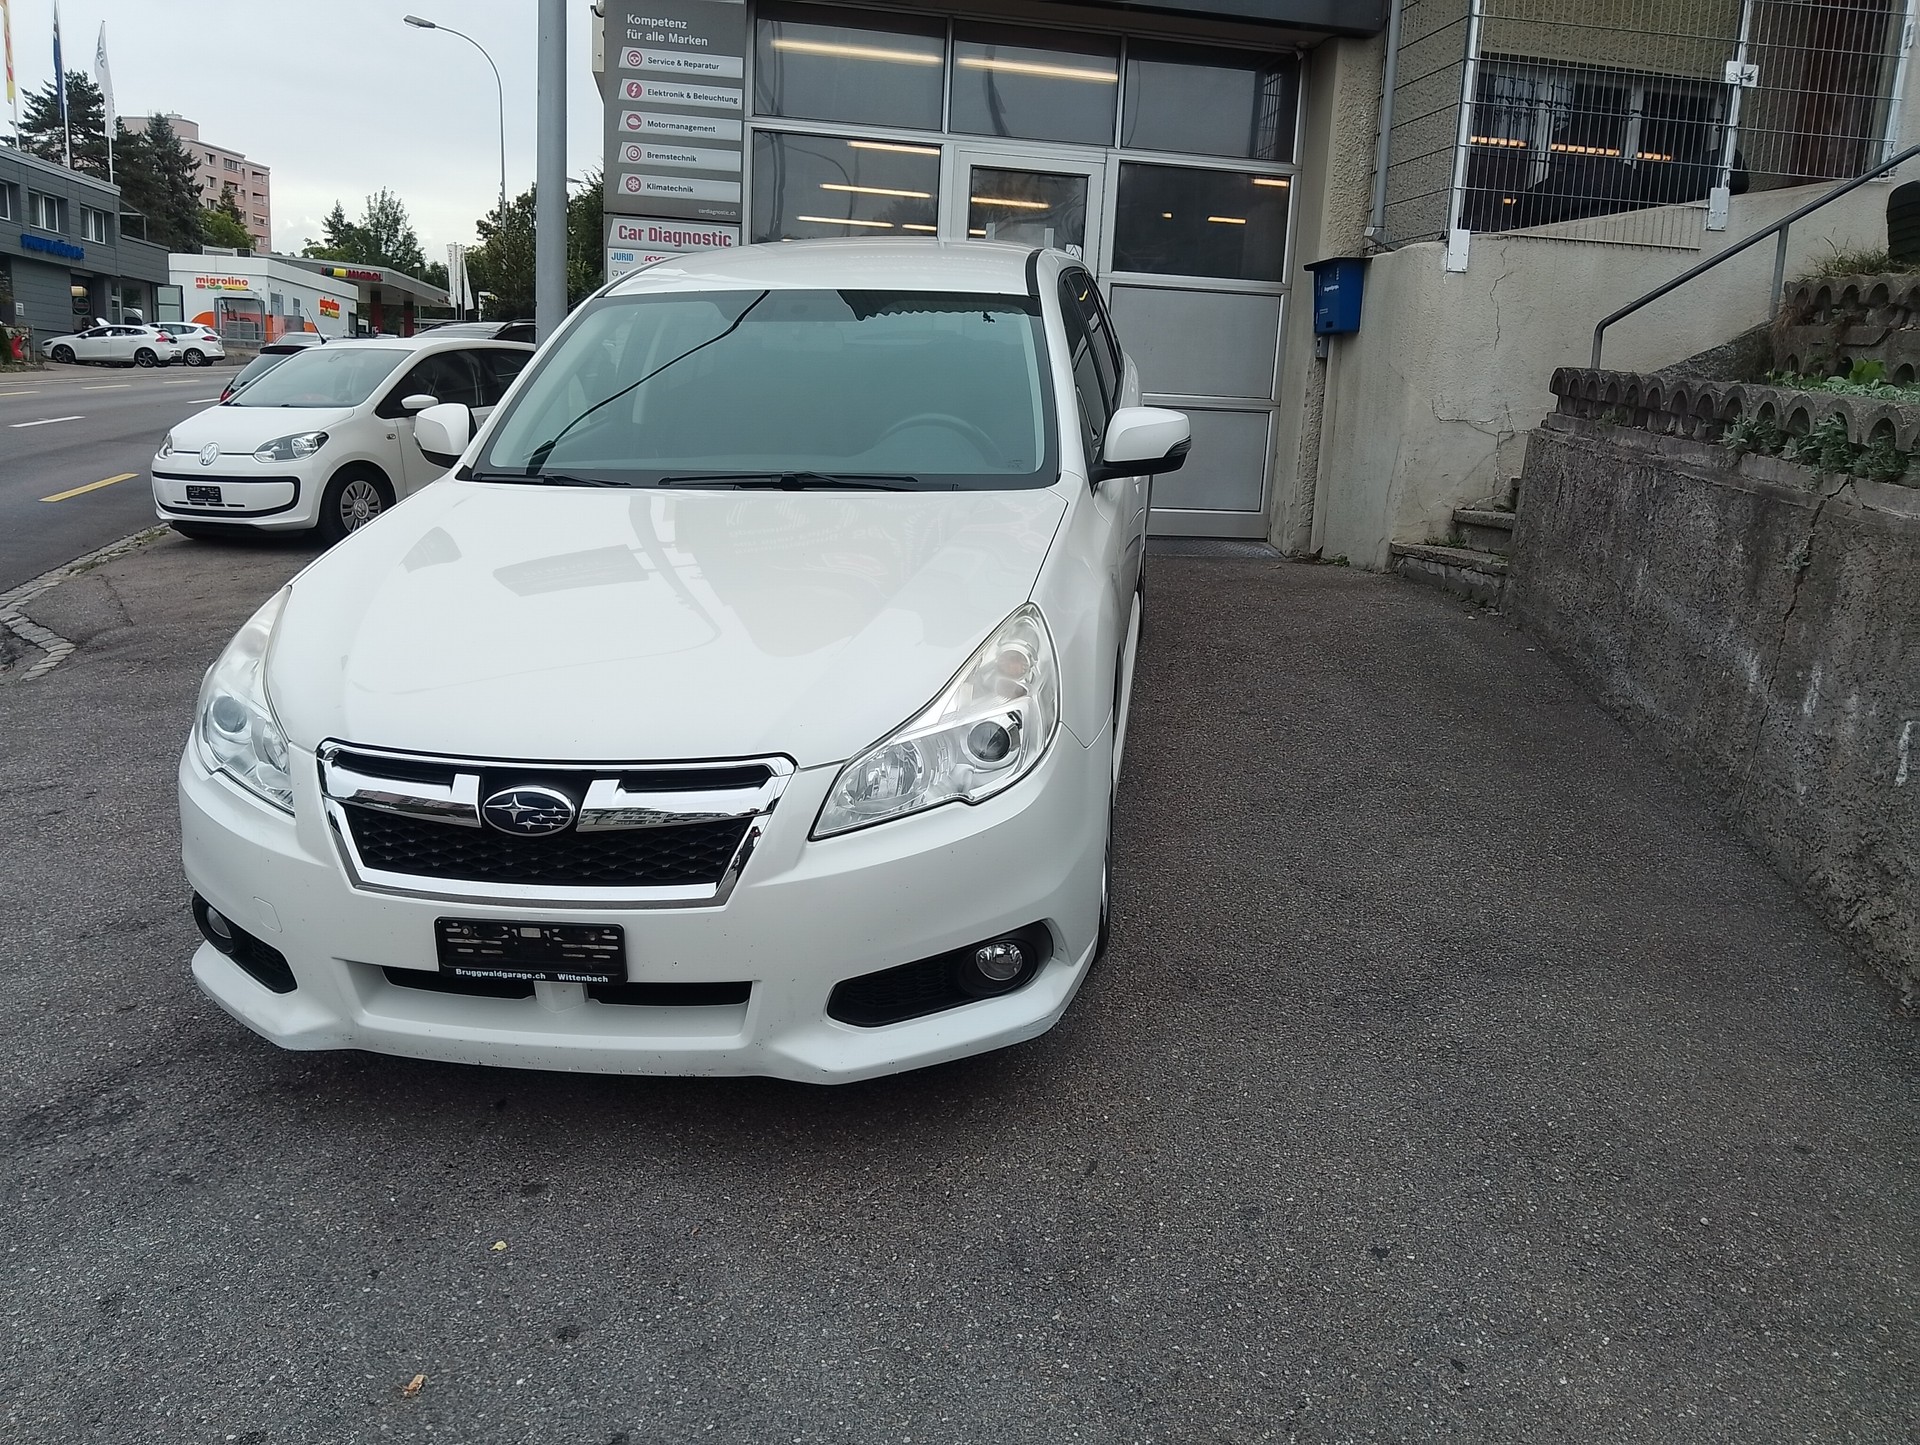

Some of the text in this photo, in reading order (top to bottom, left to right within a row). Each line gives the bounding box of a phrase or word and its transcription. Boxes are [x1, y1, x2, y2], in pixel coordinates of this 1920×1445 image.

[627, 14, 687, 29] Kompetenz
[626, 30, 708, 46] für alle Marken
[648, 57, 719, 70] Service & Reparatur
[647, 89, 738, 104] Elektronik & Beleuchtung
[647, 120, 716, 133] Motormanagement
[647, 152, 697, 162] Bremstechnik
[646, 183, 694, 193] Klimatechnik
[698, 208, 736, 216] cardiagnostic.ch
[618, 225, 732, 248] Car Diagnostic
[611, 252, 633, 261] JURID
[195, 275, 248, 286] migrolino
[456, 969, 608, 982] Bruggwaldgarage.ch Wittenbach
